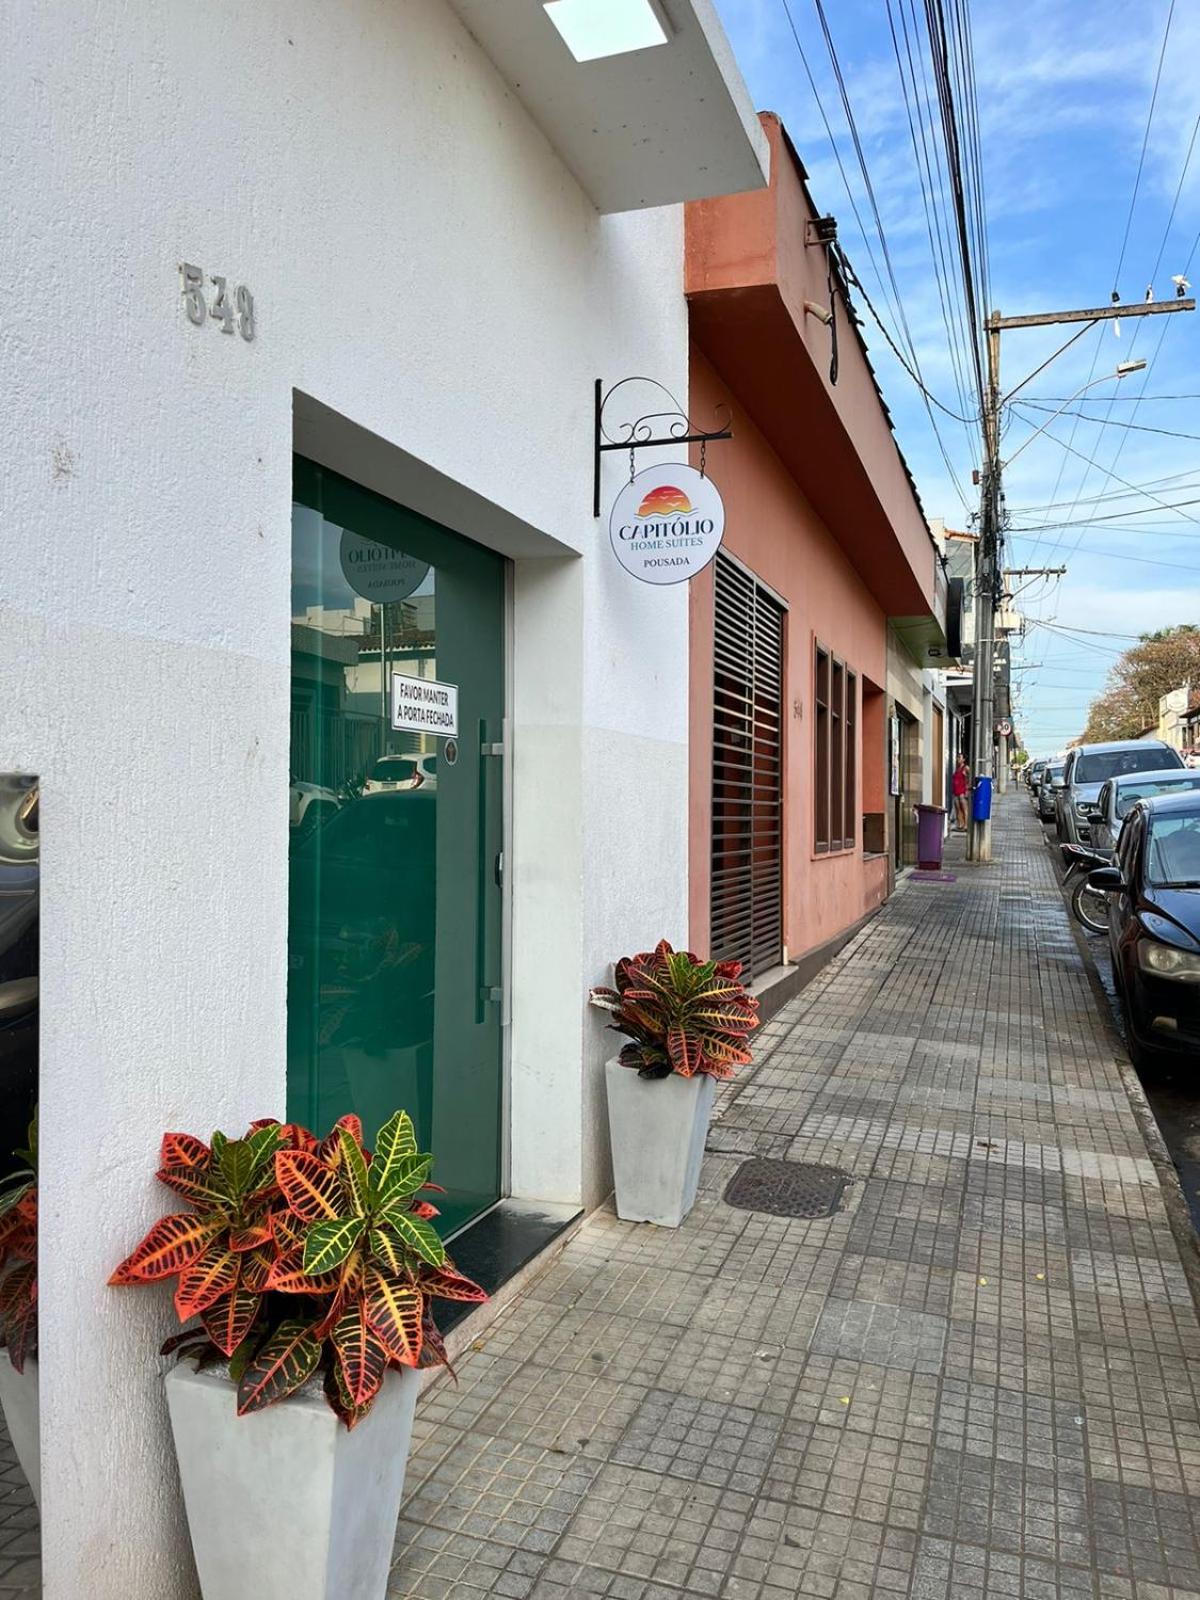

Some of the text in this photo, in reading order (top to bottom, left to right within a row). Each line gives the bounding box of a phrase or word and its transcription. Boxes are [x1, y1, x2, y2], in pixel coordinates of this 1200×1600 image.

[178, 261, 255, 343] 548
[619, 517, 714, 541] CAPITÓLIO
[630, 537, 703, 551] HOME SUITES
[643, 557, 690, 568] POUSADA
[400, 682, 449, 706] FAVOR MANTER
[397, 703, 455, 728] A PORTA FECHADA
